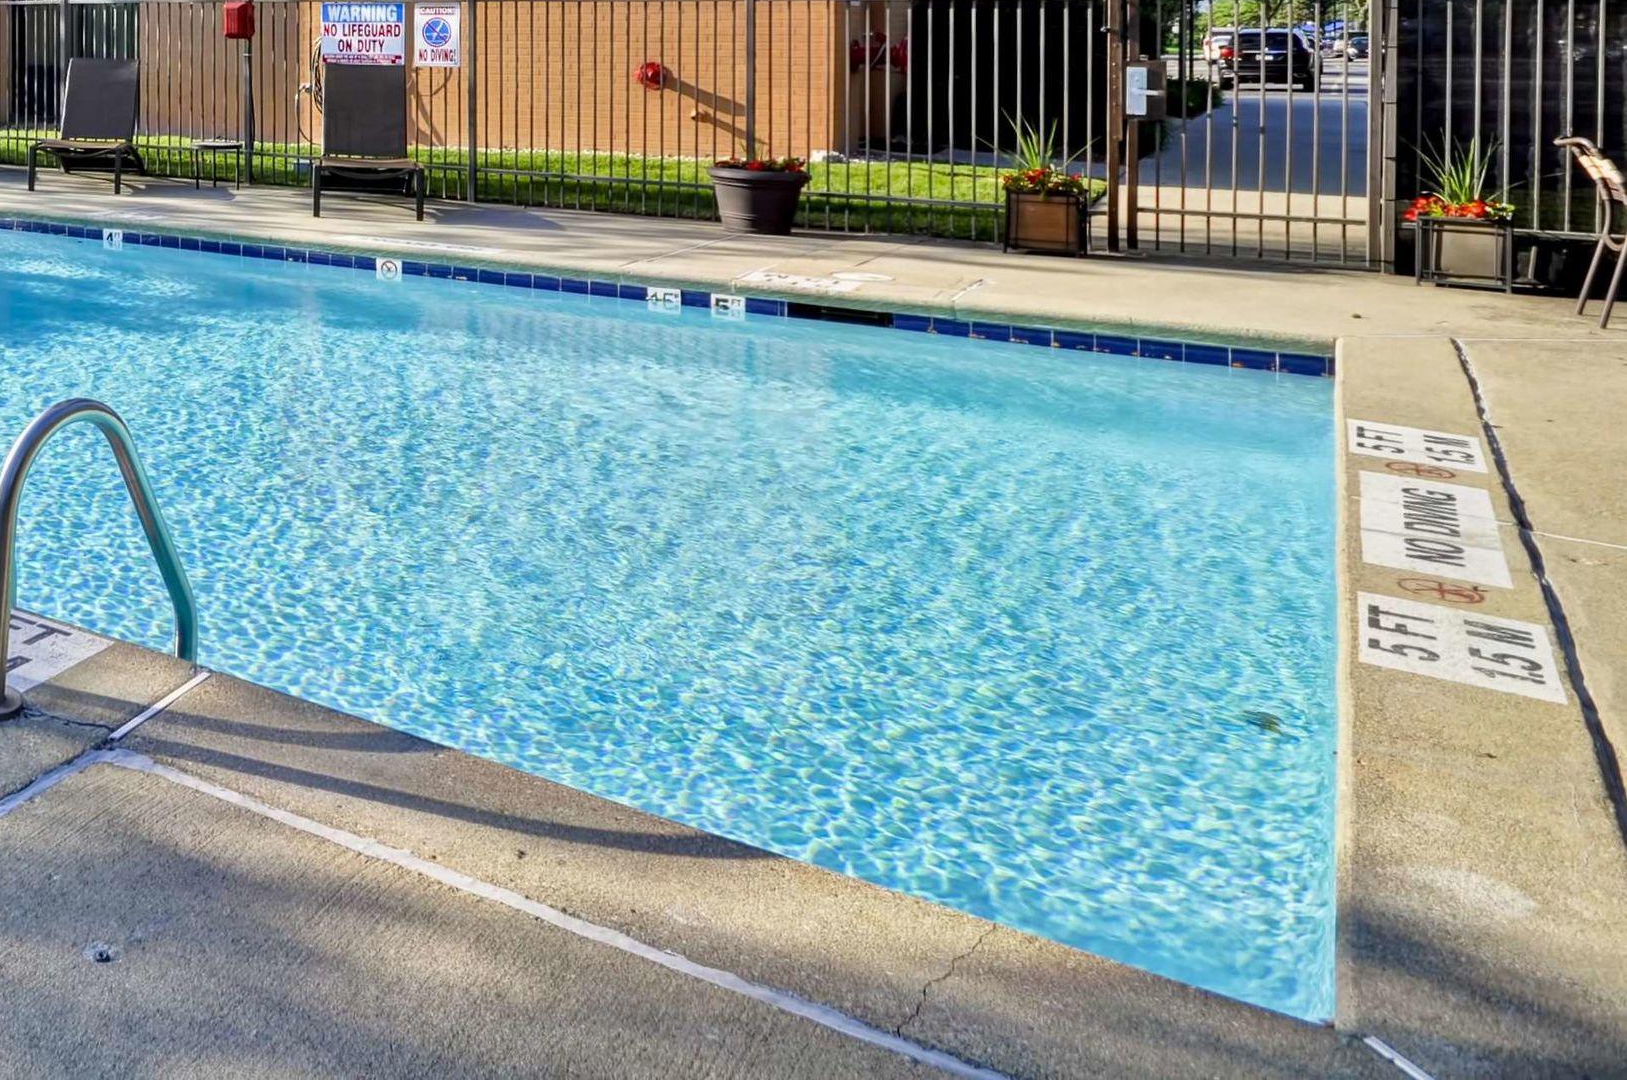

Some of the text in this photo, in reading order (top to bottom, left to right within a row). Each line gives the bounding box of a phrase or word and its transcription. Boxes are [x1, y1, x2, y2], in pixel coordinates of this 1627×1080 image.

[327, 4, 398, 22] WARNING
[323, 24, 401, 37] NO LIFEGUARD
[338, 39, 385, 52] ON DUTY
[419, 49, 457, 61] NO DIVING!
[715, 297, 741, 310] 5 FT
[1356, 426, 1405, 454] 5 FT
[1423, 434, 1472, 449] M
[1401, 487, 1467, 568] NO DIVING
[1367, 604, 1441, 662] 5 FT
[1462, 619, 1548, 685] 1.5 M
